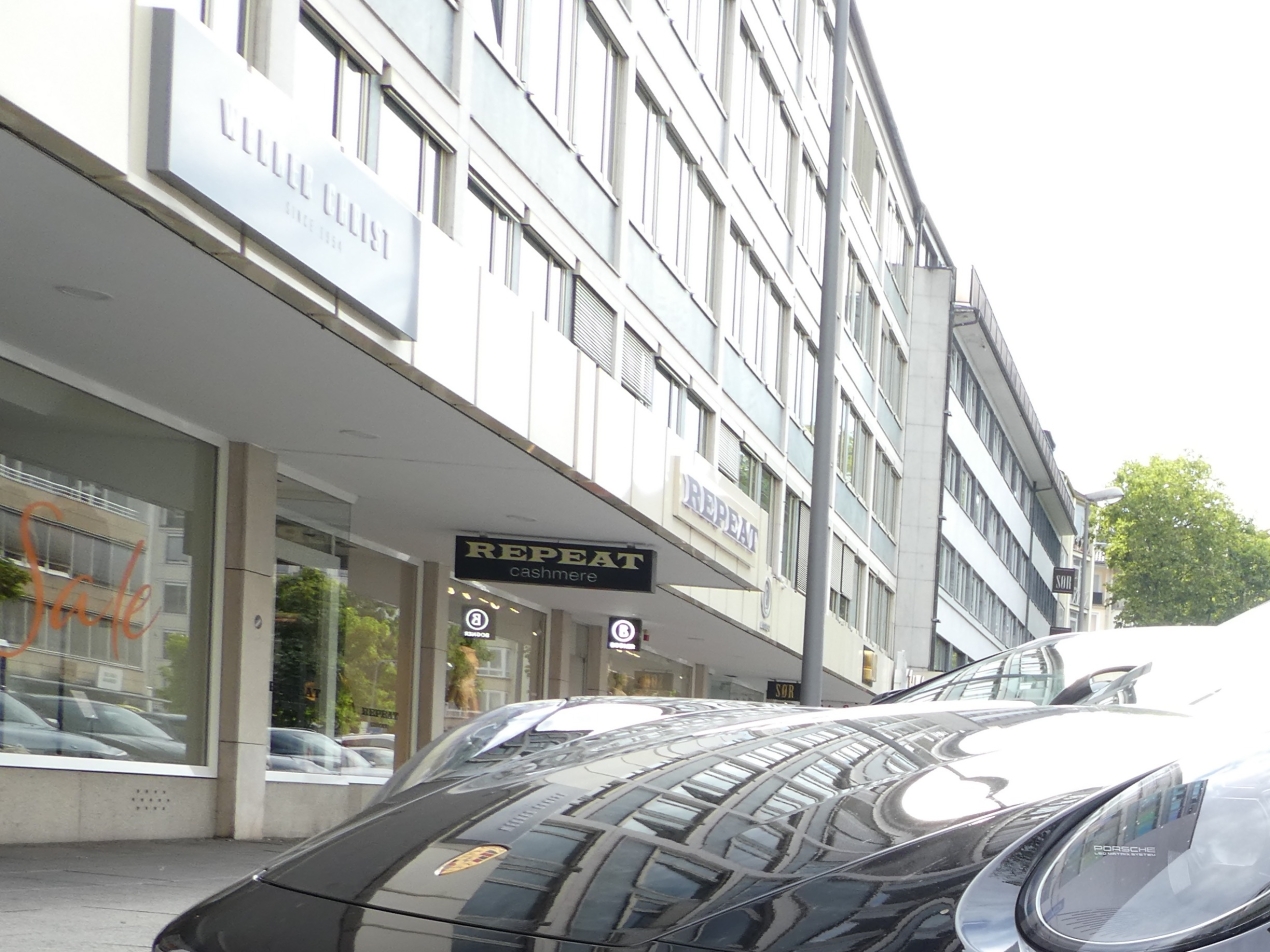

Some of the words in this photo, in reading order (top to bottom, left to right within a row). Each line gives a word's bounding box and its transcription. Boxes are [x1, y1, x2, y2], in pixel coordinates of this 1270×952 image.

[323, 182, 392, 261] CHRIST
[682, 473, 759, 554] REPEAT
[465, 540, 645, 570] REPEAT
[0, 501, 162, 661] Sale
[509, 565, 598, 583] cashmere
[361, 706, 399, 721] REPEAT
[1093, 845, 1156, 853] PORSCHE
